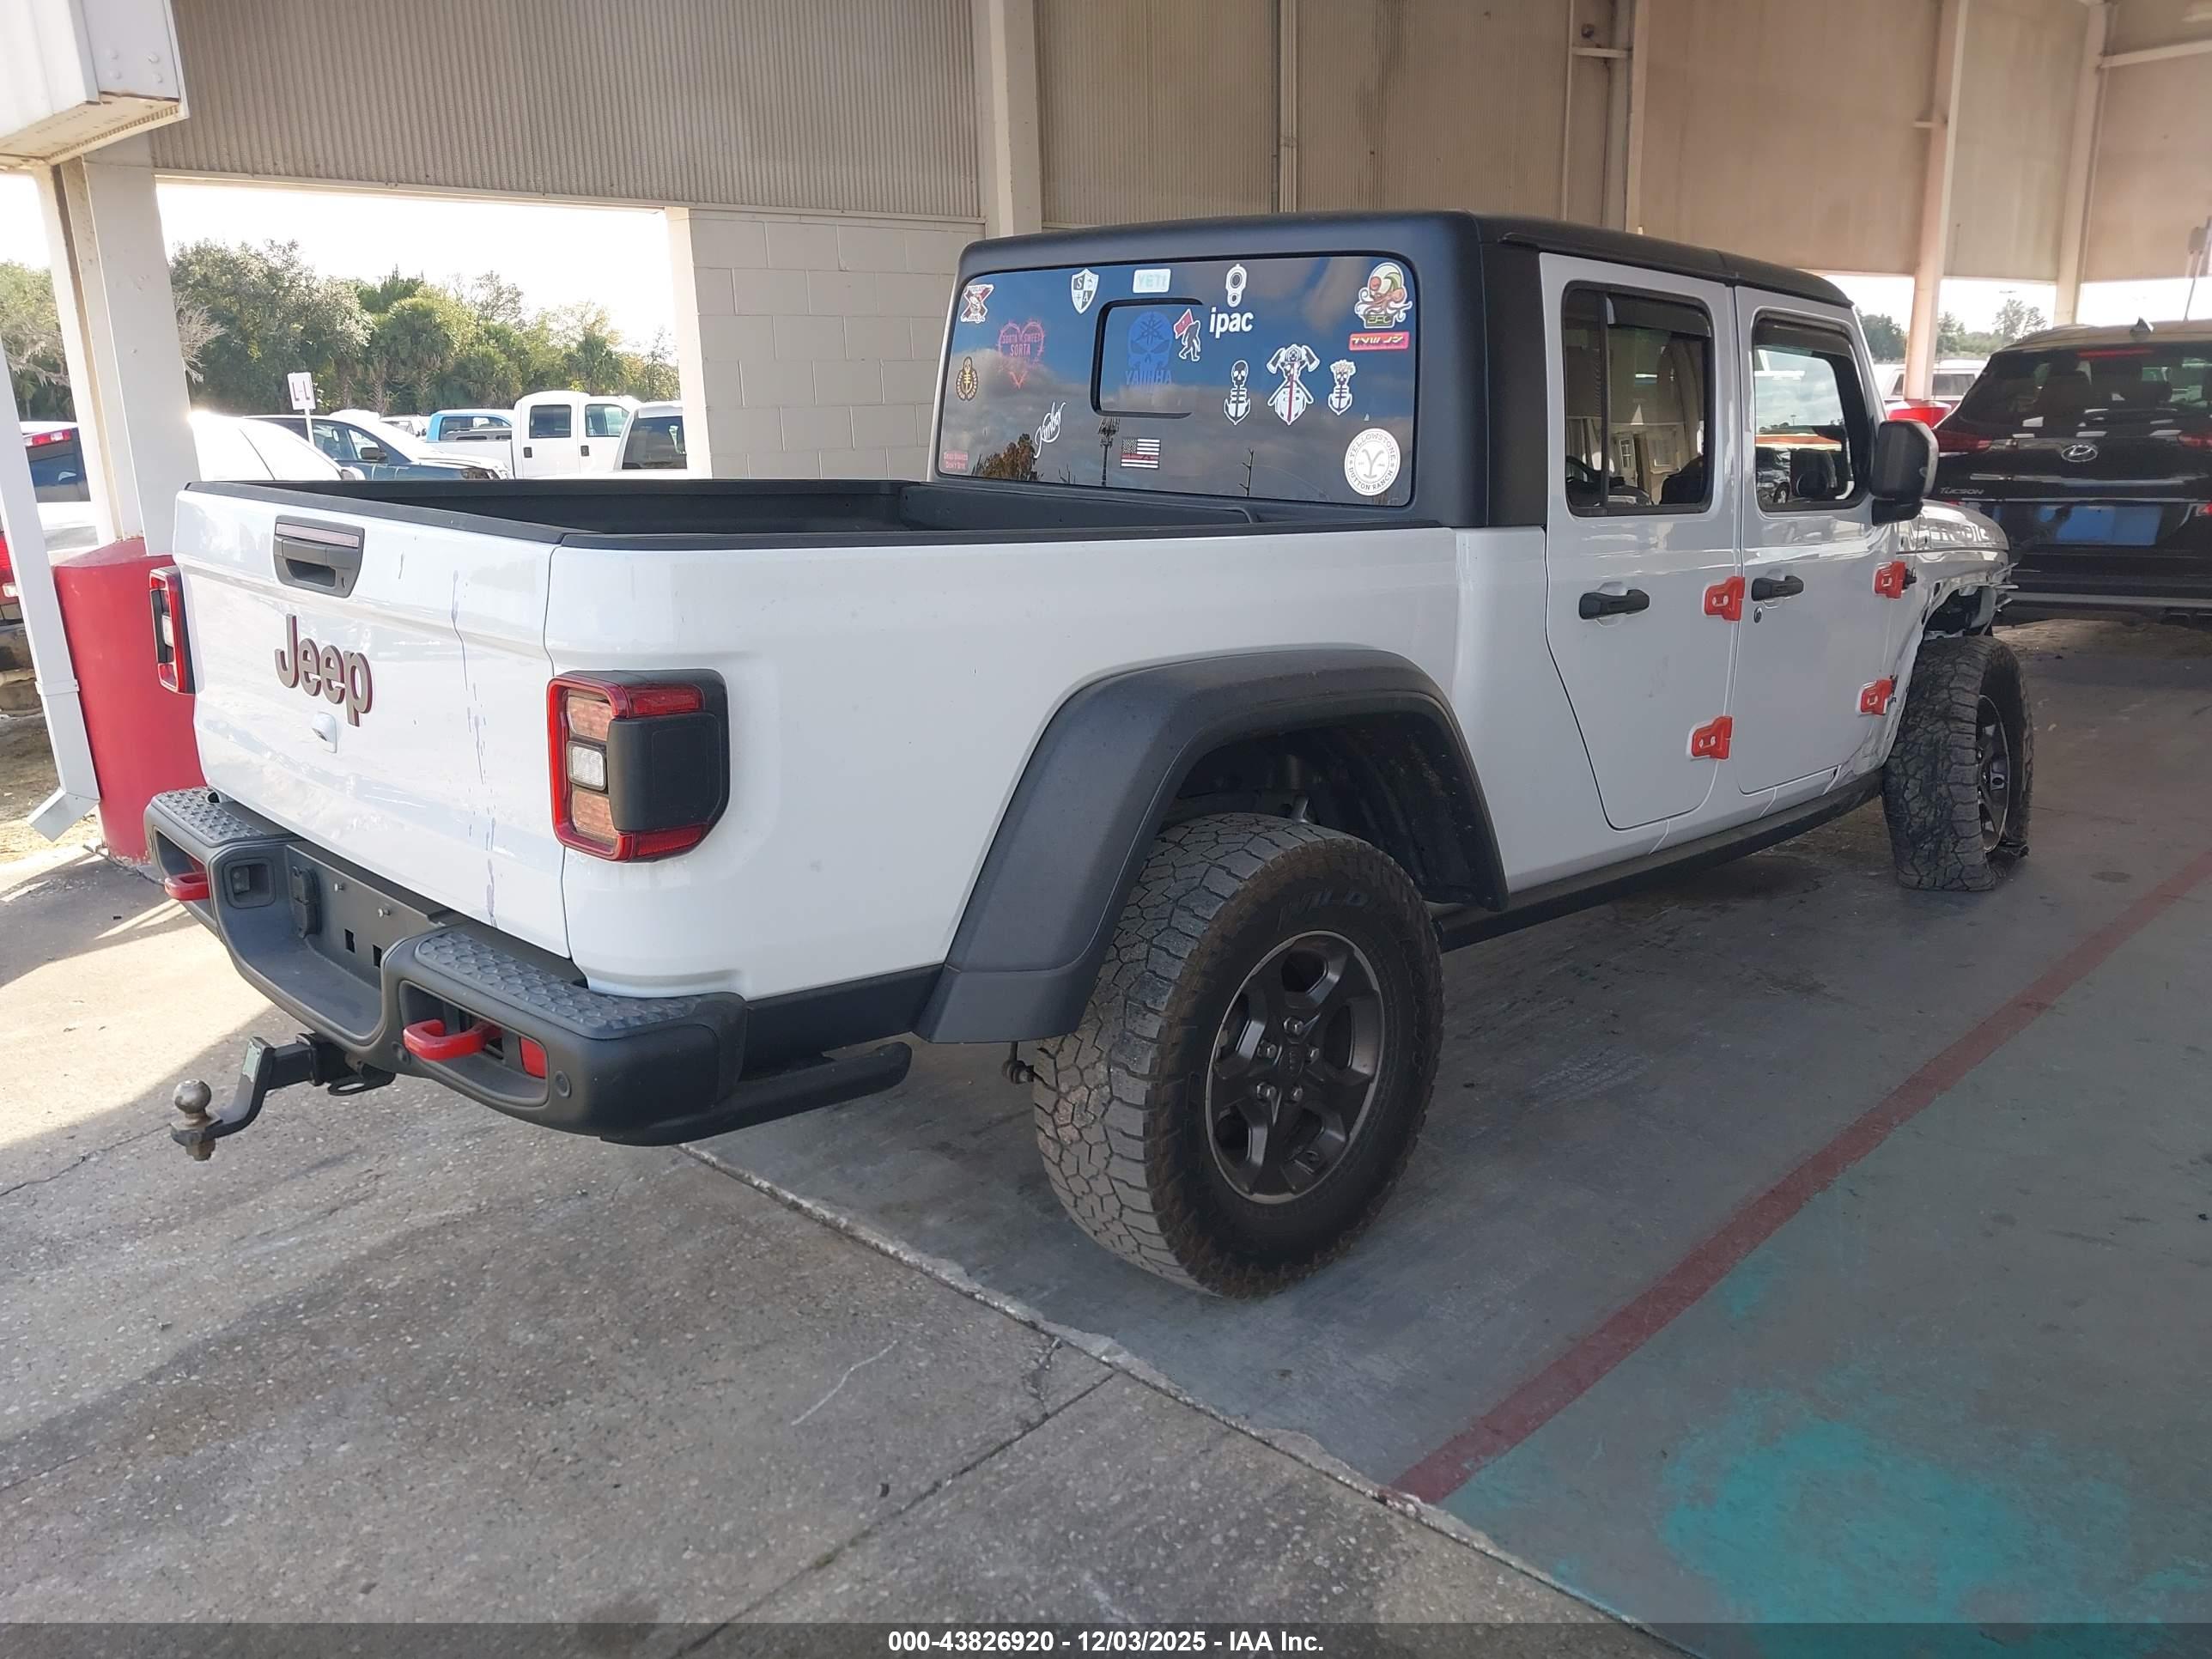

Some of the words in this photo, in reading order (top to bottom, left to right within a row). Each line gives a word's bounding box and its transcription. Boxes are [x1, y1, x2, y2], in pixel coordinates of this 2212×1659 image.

[1137, 274, 1167, 288] YETI
[1209, 307, 1254, 338] ipac
[1010, 343, 1030, 356] SORTA
[1350, 433, 1396, 461] YELLOWSTONE
[1348, 466, 1370, 490] DUTTON
[1372, 470, 1394, 491] RANCH
[274, 613, 373, 727] Jeep
